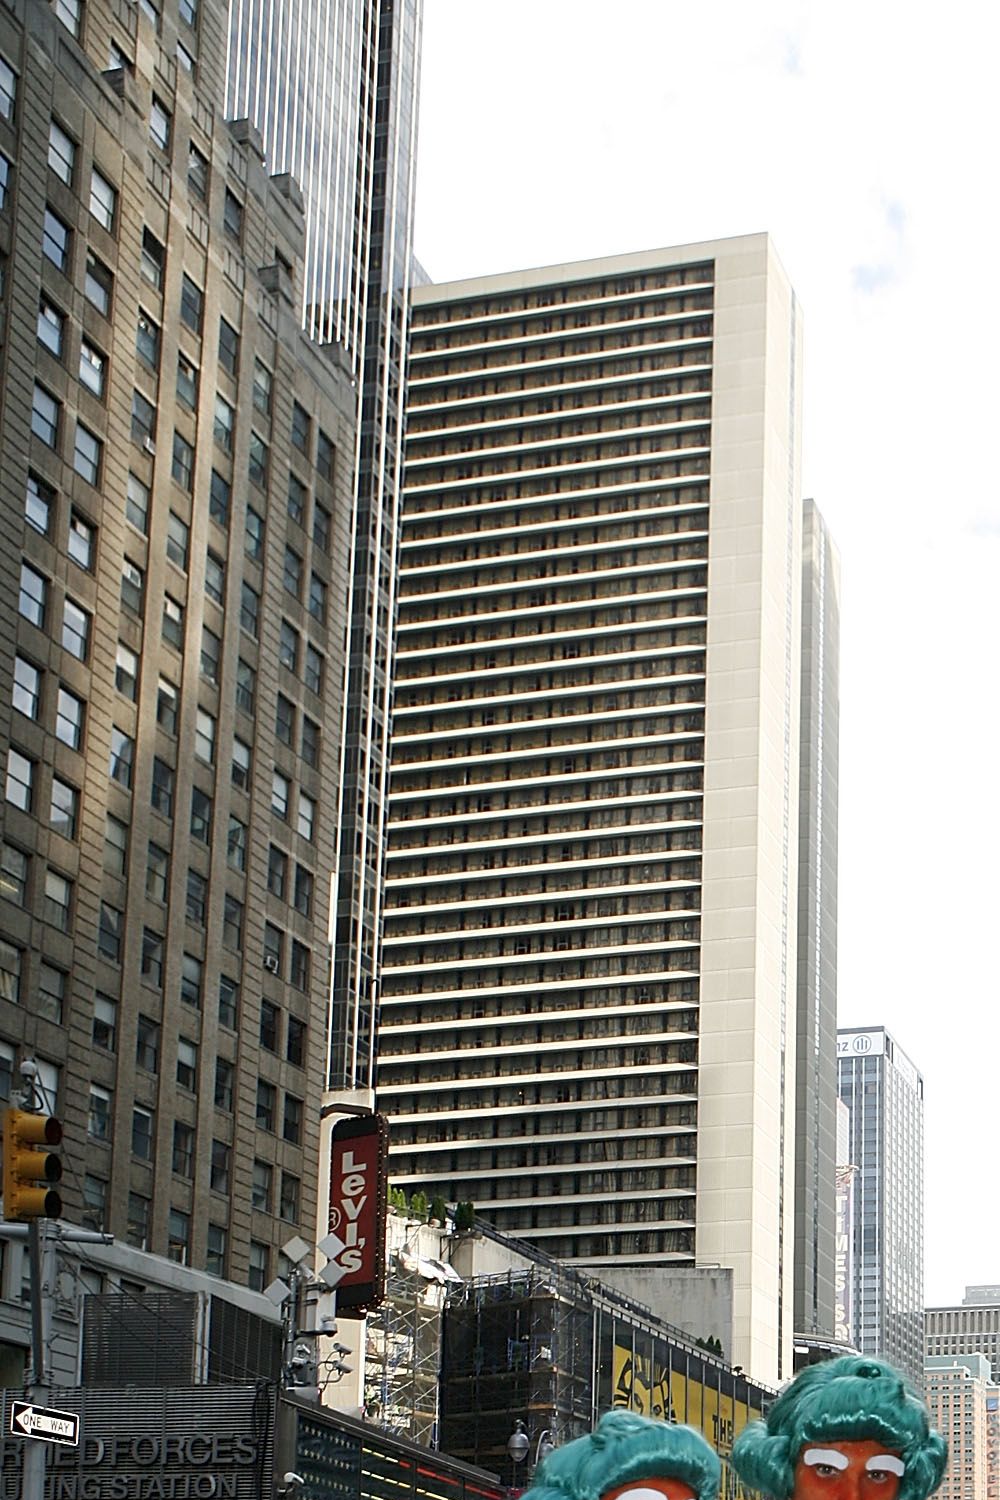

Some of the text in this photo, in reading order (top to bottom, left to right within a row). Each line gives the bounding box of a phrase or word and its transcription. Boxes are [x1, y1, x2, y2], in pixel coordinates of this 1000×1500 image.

[23, 1414, 70, 1434] ONE WAY
[112, 1434, 257, 1466] FORCES
[110, 1475, 238, 1499] STATION
